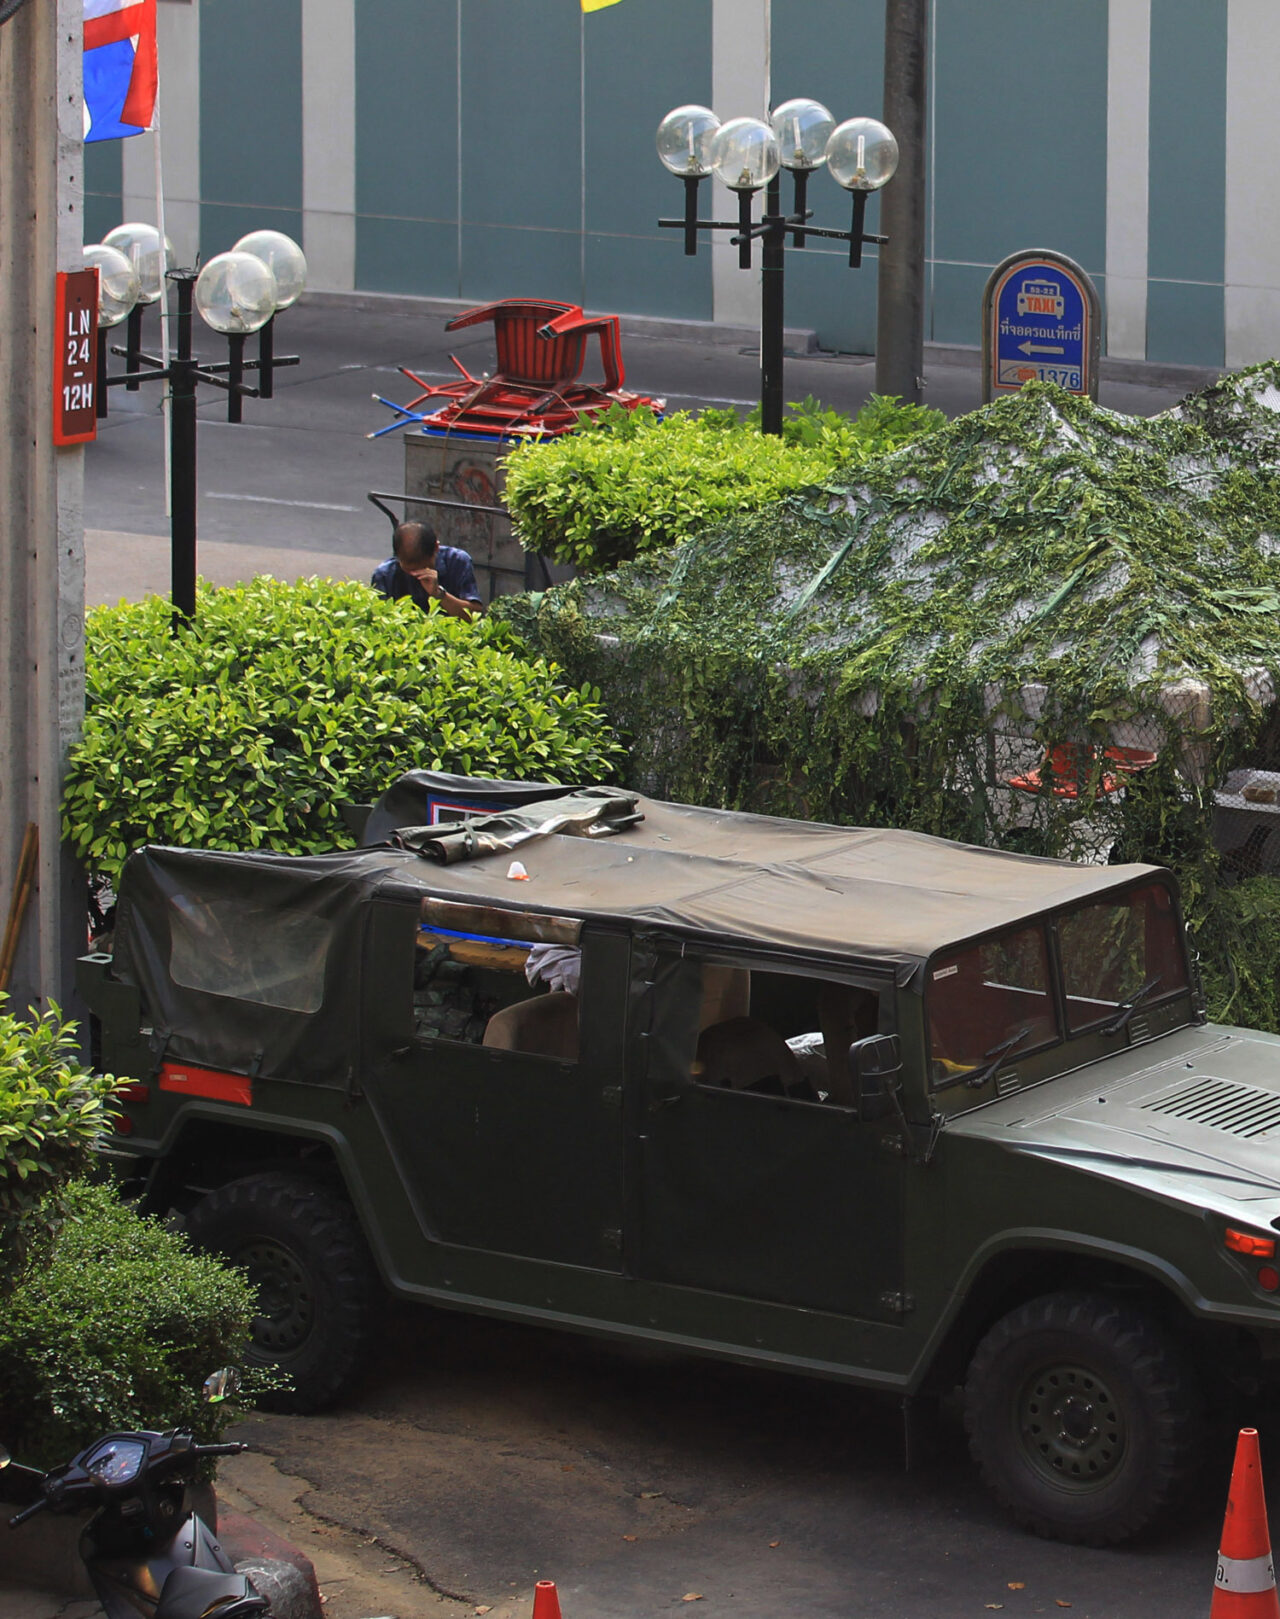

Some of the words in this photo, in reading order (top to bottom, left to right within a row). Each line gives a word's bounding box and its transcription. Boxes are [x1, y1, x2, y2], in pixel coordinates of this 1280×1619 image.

[1026, 297, 1055, 313] TAXI
[68, 309, 90, 337] LN
[67, 338, 90, 366] 24
[63, 383, 93, 411] 12H
